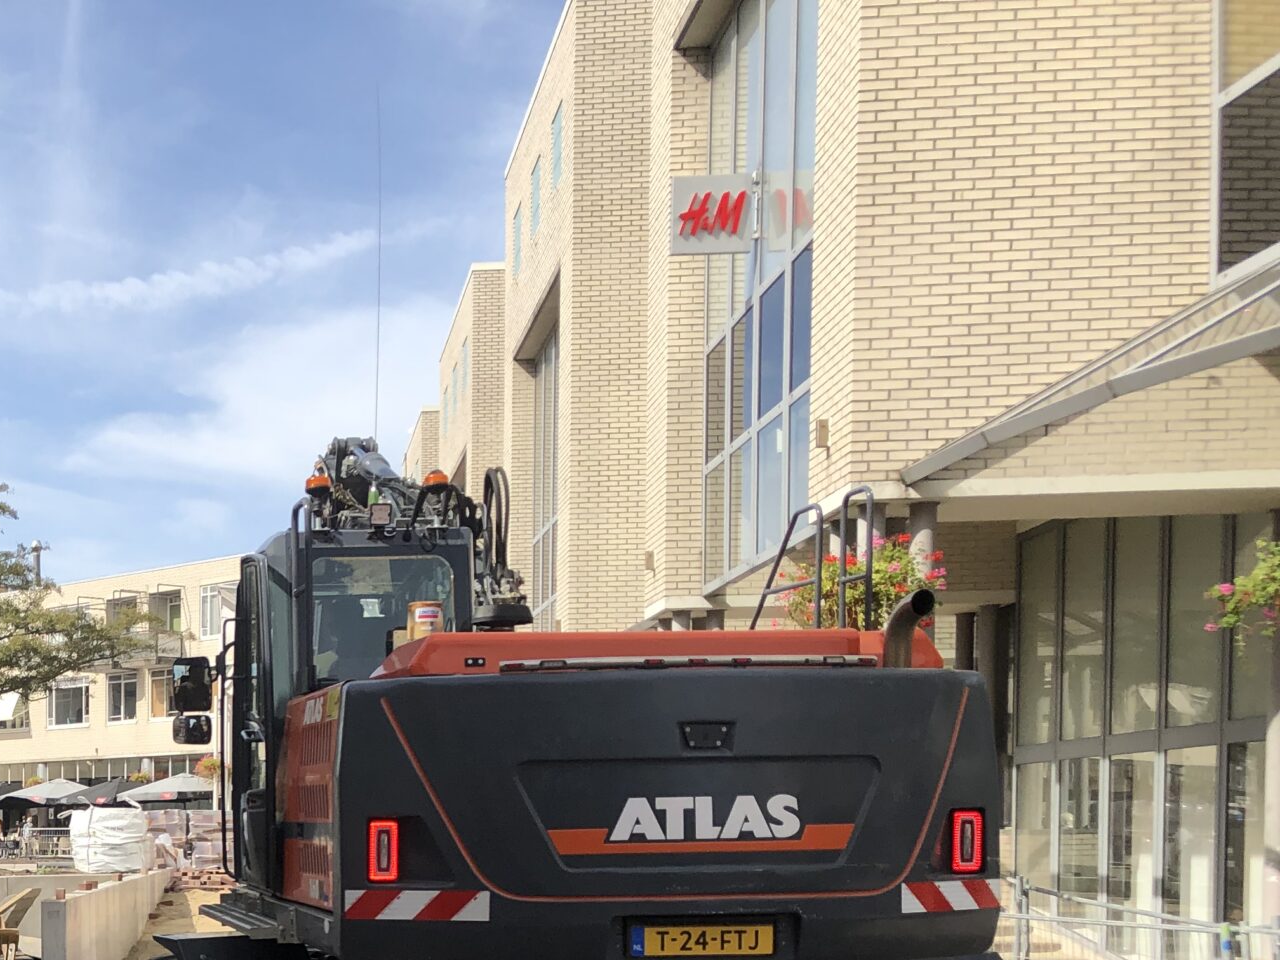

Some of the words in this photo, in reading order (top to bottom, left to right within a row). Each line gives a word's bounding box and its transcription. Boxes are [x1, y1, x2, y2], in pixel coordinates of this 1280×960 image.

[678, 190, 747, 237] H&M
[609, 793, 801, 842] ATLAS
[656, 929, 760, 951] T-24-FTJ
